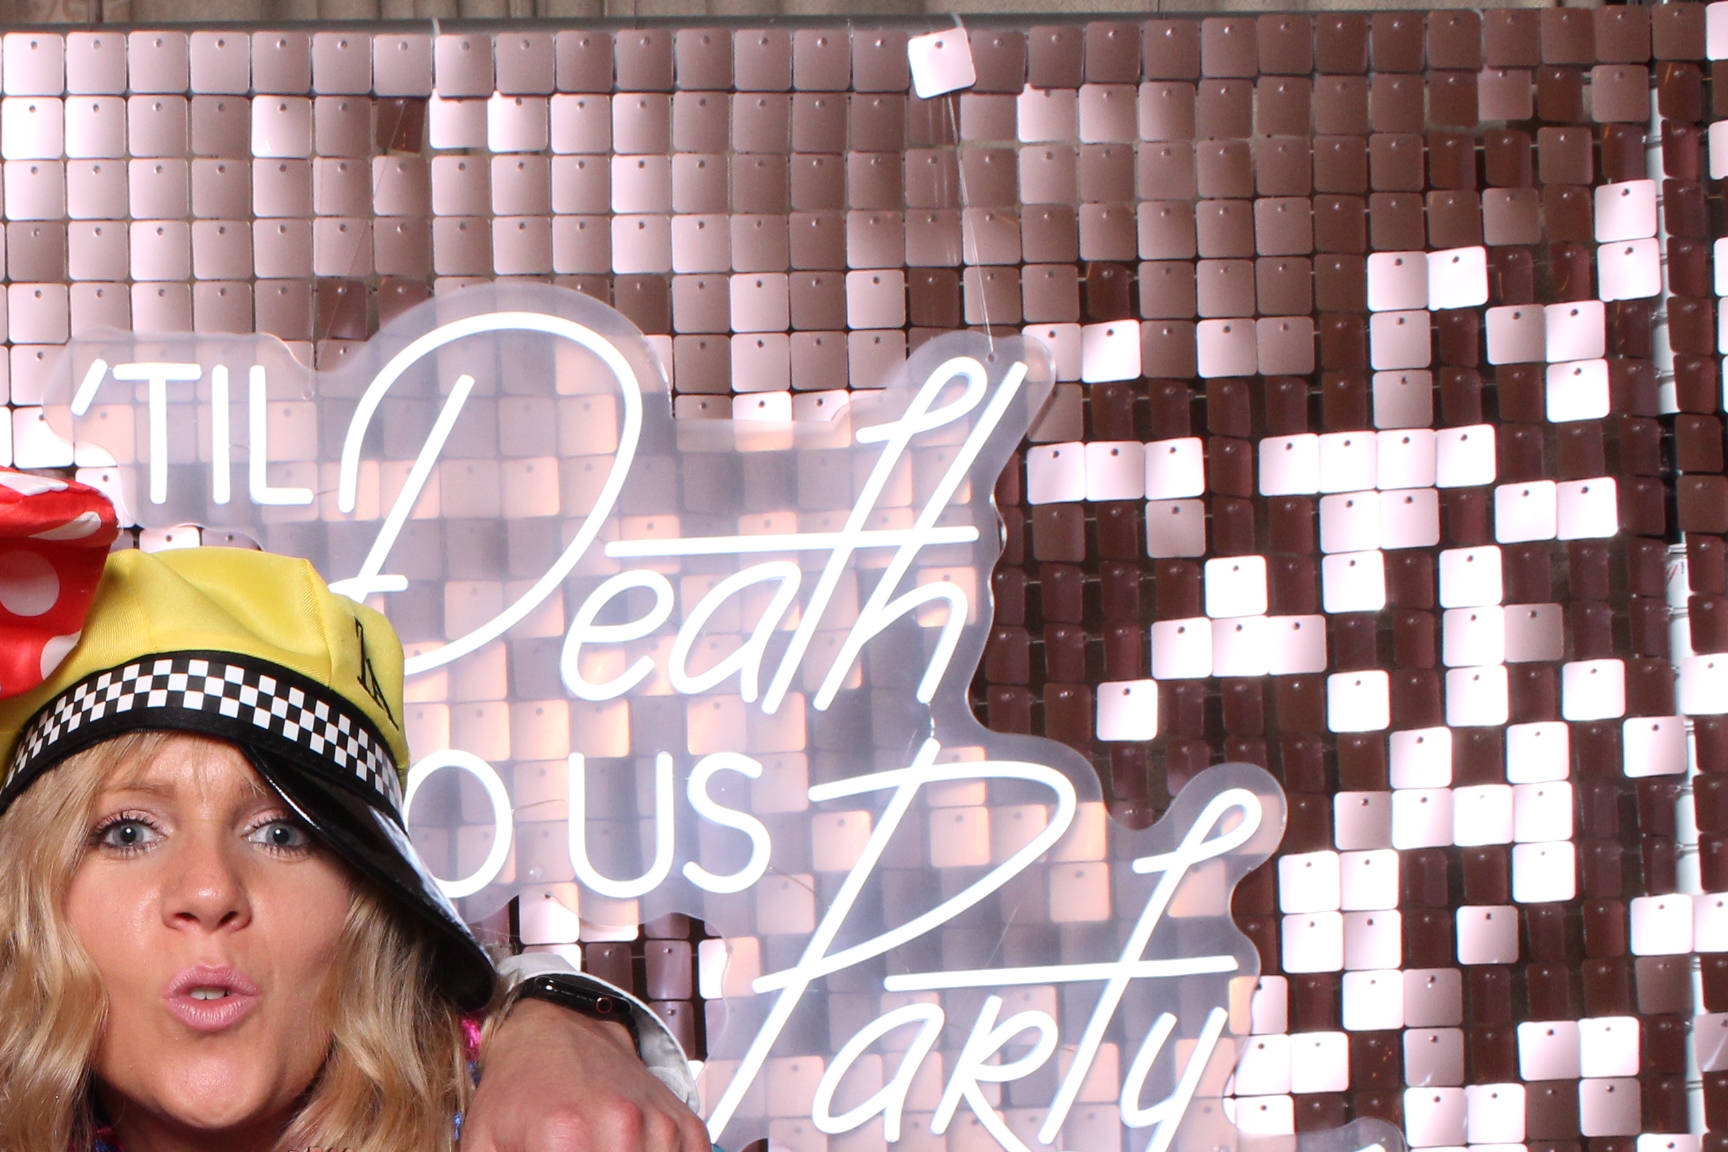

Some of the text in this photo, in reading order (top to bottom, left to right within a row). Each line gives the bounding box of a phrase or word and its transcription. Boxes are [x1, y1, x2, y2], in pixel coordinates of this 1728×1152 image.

[332, 310, 1029, 712] Death
[405, 749, 513, 898] O
[568, 751, 771, 898] US
